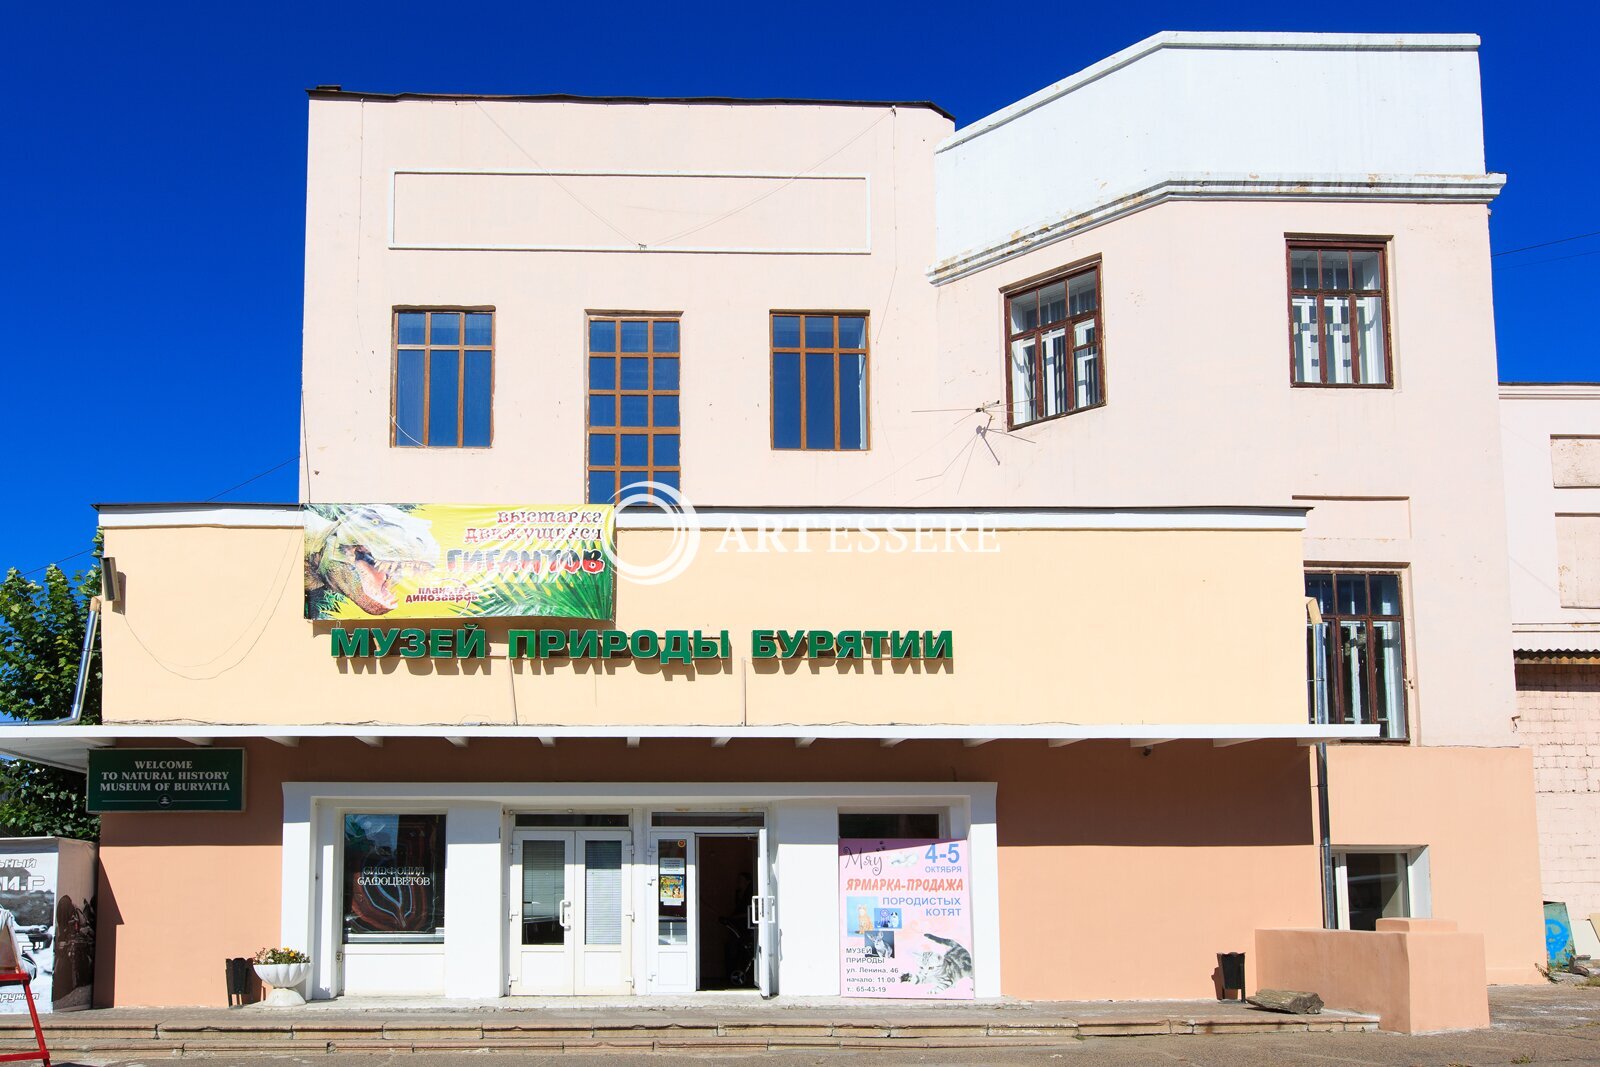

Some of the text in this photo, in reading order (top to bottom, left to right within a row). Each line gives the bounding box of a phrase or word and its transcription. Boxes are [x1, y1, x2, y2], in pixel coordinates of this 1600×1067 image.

[330, 623, 953, 664] МУЗЕЙ ПРИРОДЫ БУРЯТИИ
[135, 761, 193, 769] WELCOME
[102, 772, 229, 780] TO NATURAL HISTORY
[100, 783, 230, 791] MUSEUM OF BURYATIA
[925, 843, 960, 864] 4-5
[843, 846, 882, 876] Мяу
[846, 879, 963, 892] ЯРМАРКА-ПРОДАЖА
[883, 897, 961, 906] ПОРОДИСТЫХ
[926, 908, 961, 916] КОТЯТ
